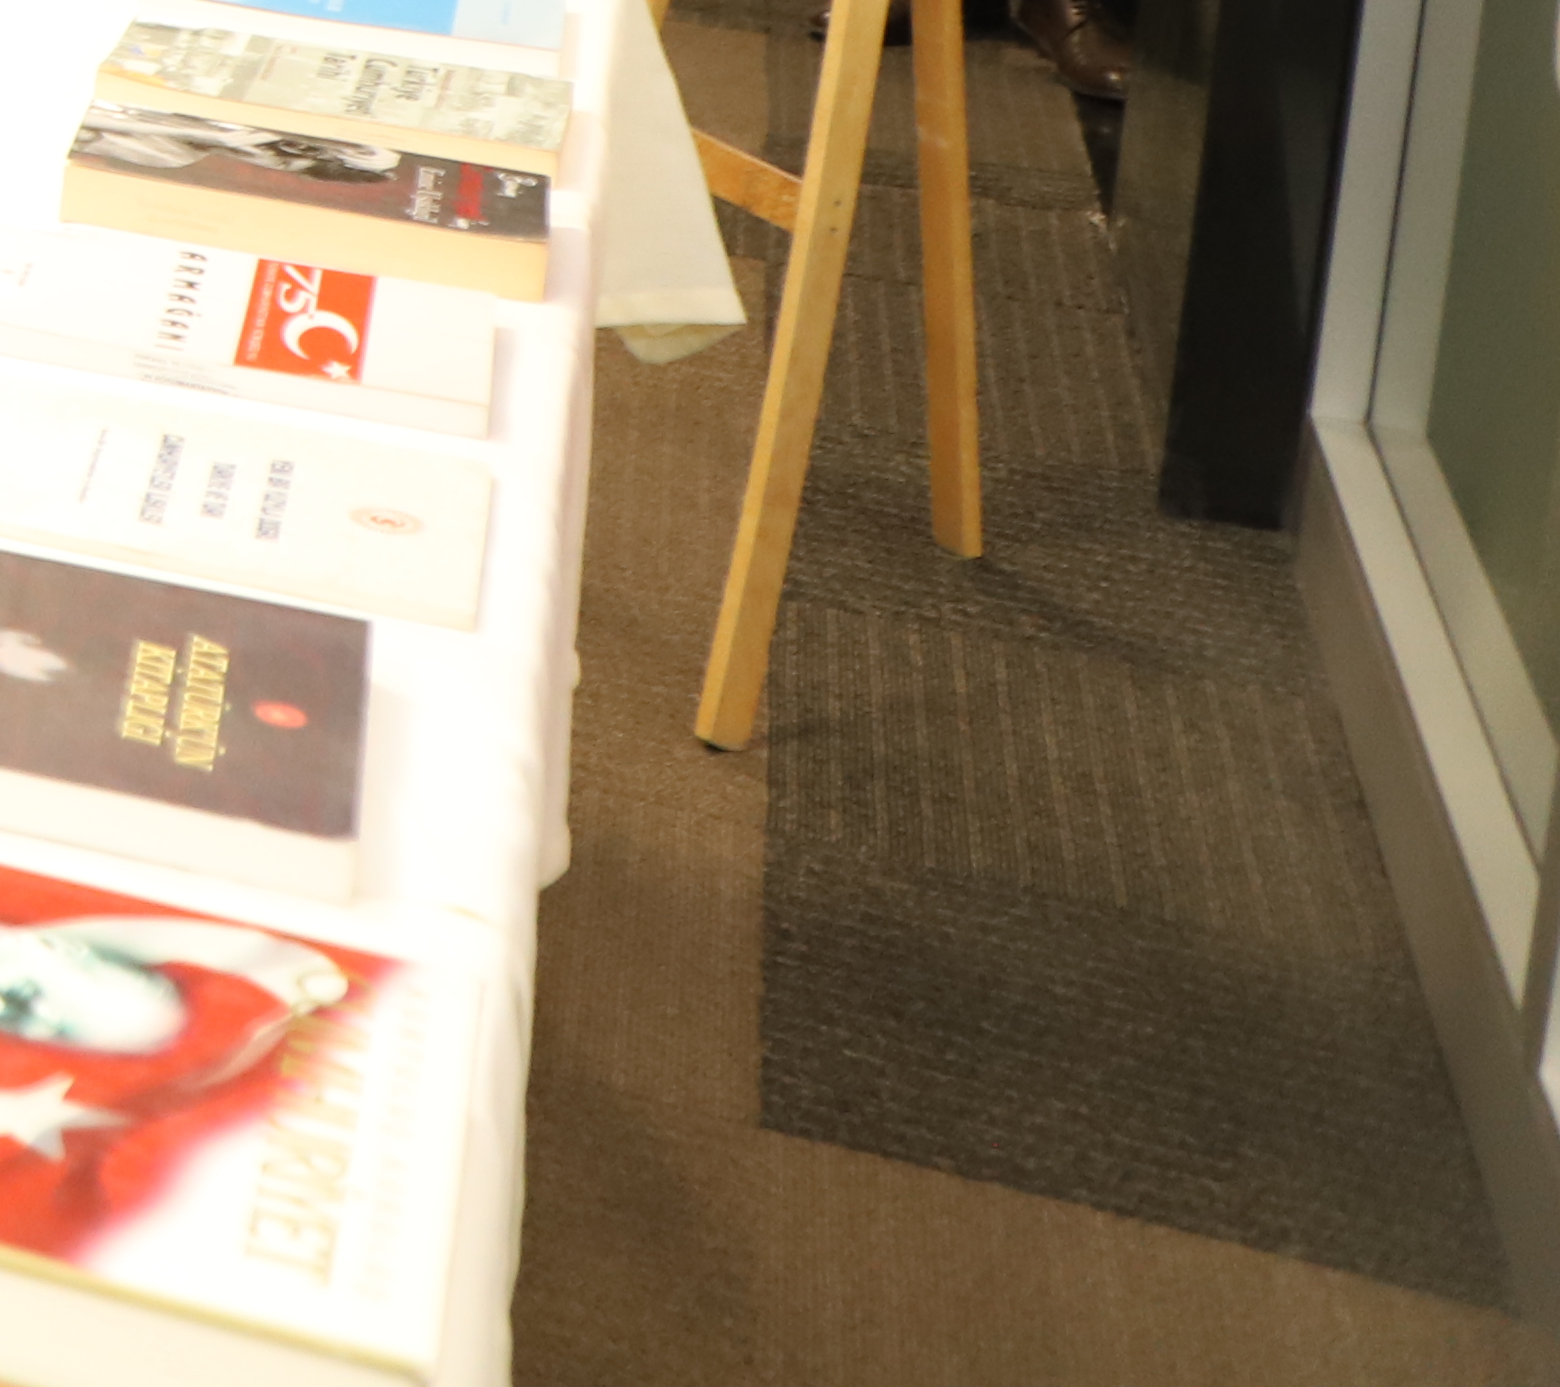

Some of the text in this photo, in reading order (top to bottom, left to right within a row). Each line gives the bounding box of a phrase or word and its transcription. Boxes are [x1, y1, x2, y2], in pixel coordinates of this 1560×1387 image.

[155, 250, 208, 351] ARMAĞANI
[277, 264, 323, 313] 75
[121, 641, 180, 745] KİTAPLIĞI
